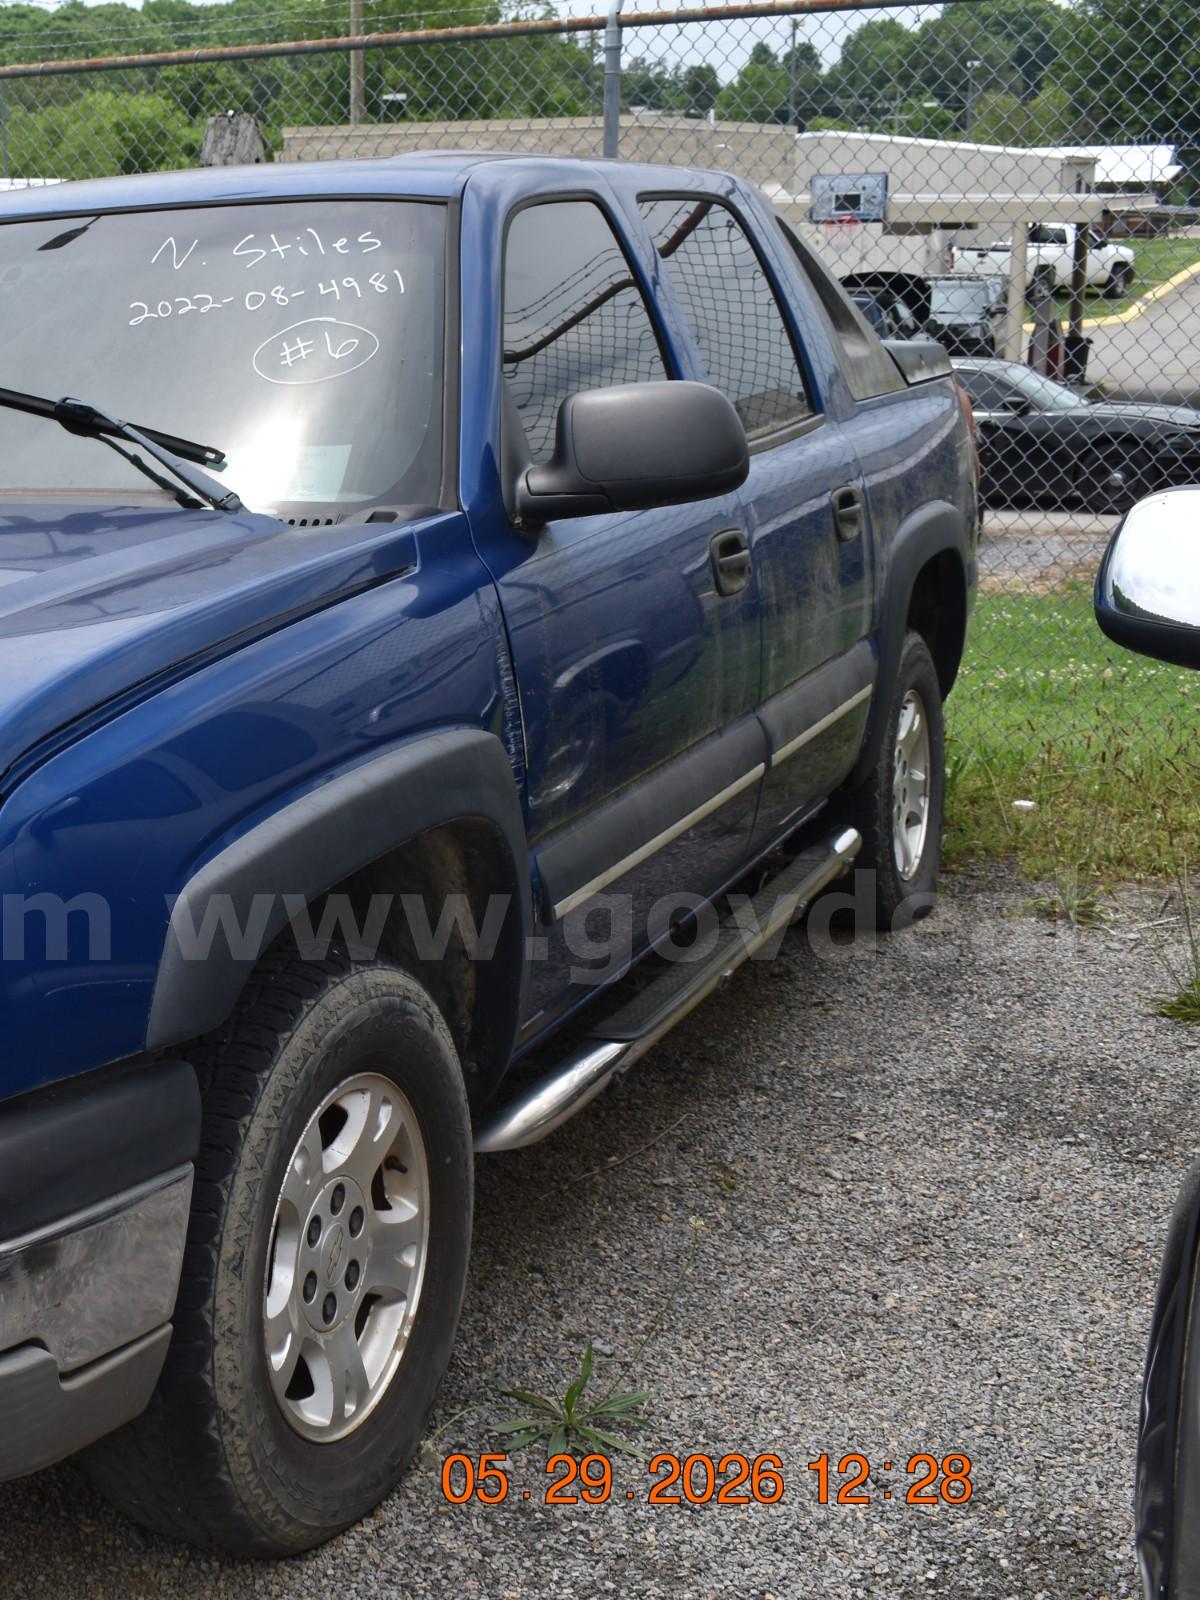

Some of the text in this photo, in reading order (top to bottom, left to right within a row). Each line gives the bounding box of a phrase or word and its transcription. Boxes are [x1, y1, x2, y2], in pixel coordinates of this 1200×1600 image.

[233, 228, 382, 268] Stiles
[128, 269, 406, 327] 2022-08-4981
[278, 331, 360, 367] #6
